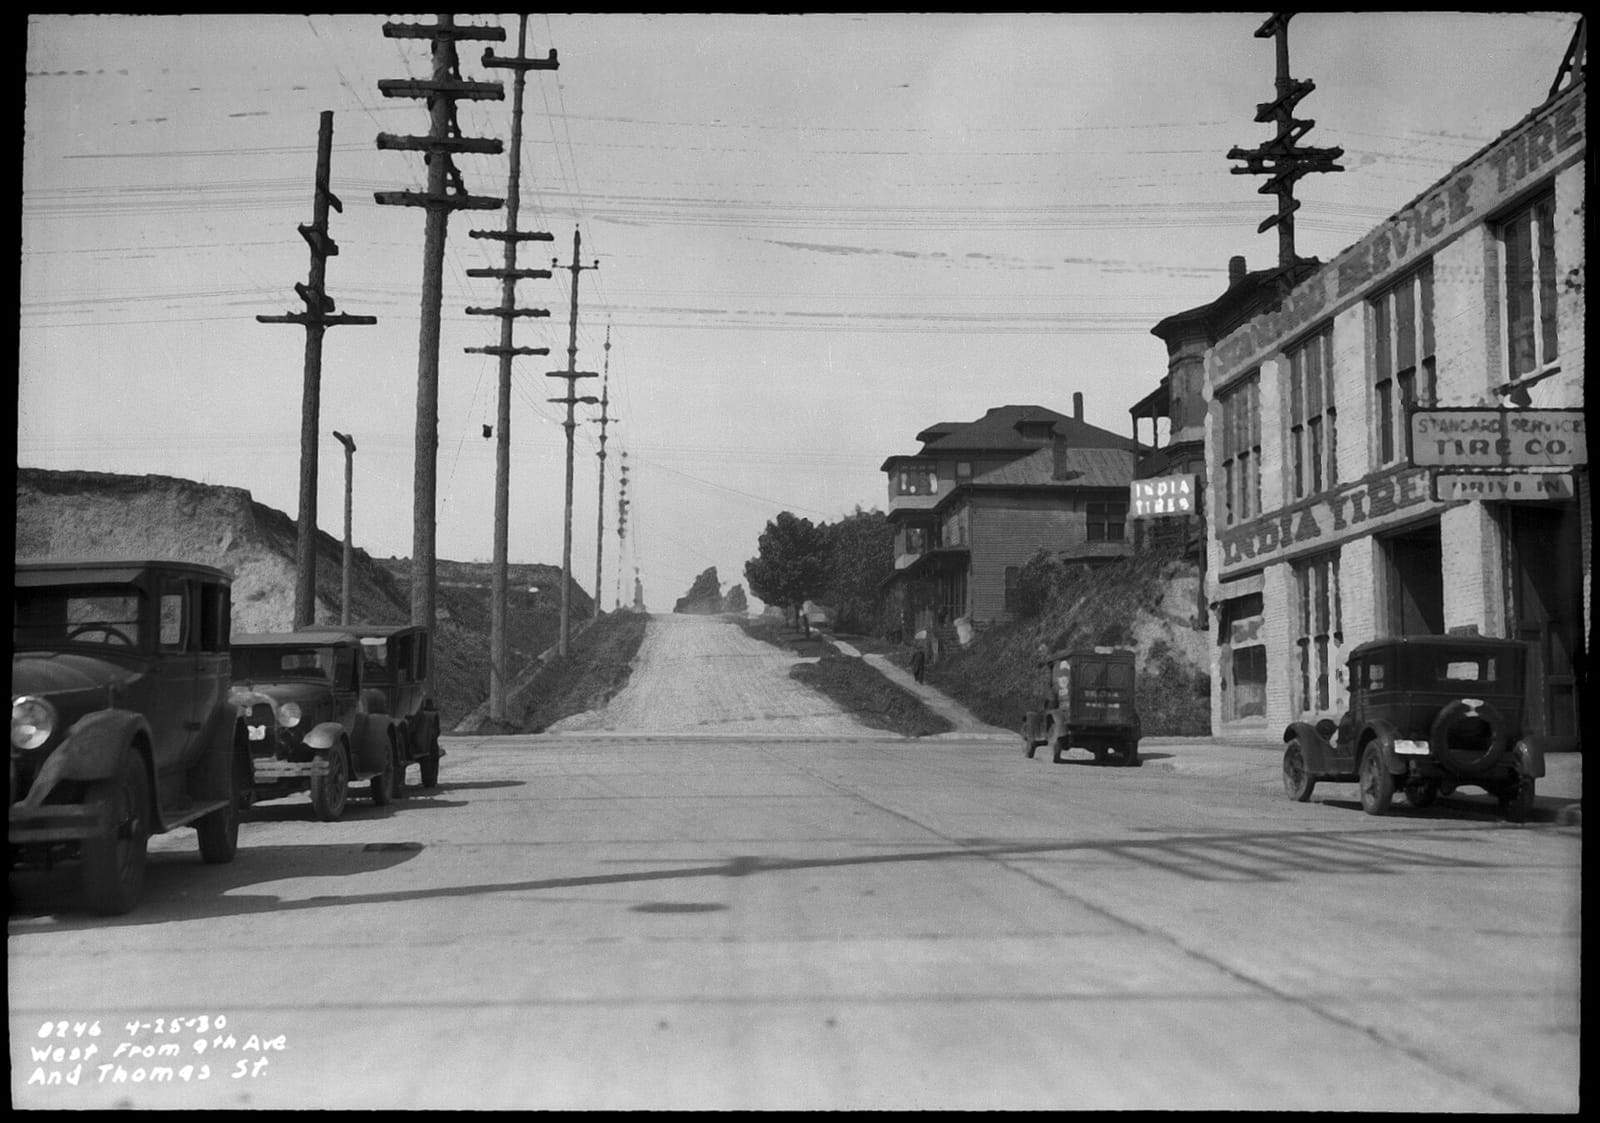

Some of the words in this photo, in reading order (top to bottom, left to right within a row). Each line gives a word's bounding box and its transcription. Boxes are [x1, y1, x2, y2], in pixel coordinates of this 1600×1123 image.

[1489, 93, 1584, 193] TIRE
[1434, 439, 1511, 456] TIRE
[1525, 439, 1573, 456] CO.
[1136, 480, 1190, 497] INDIA
[1537, 480, 1561, 494] IN
[1221, 504, 1322, 567] INDIA
